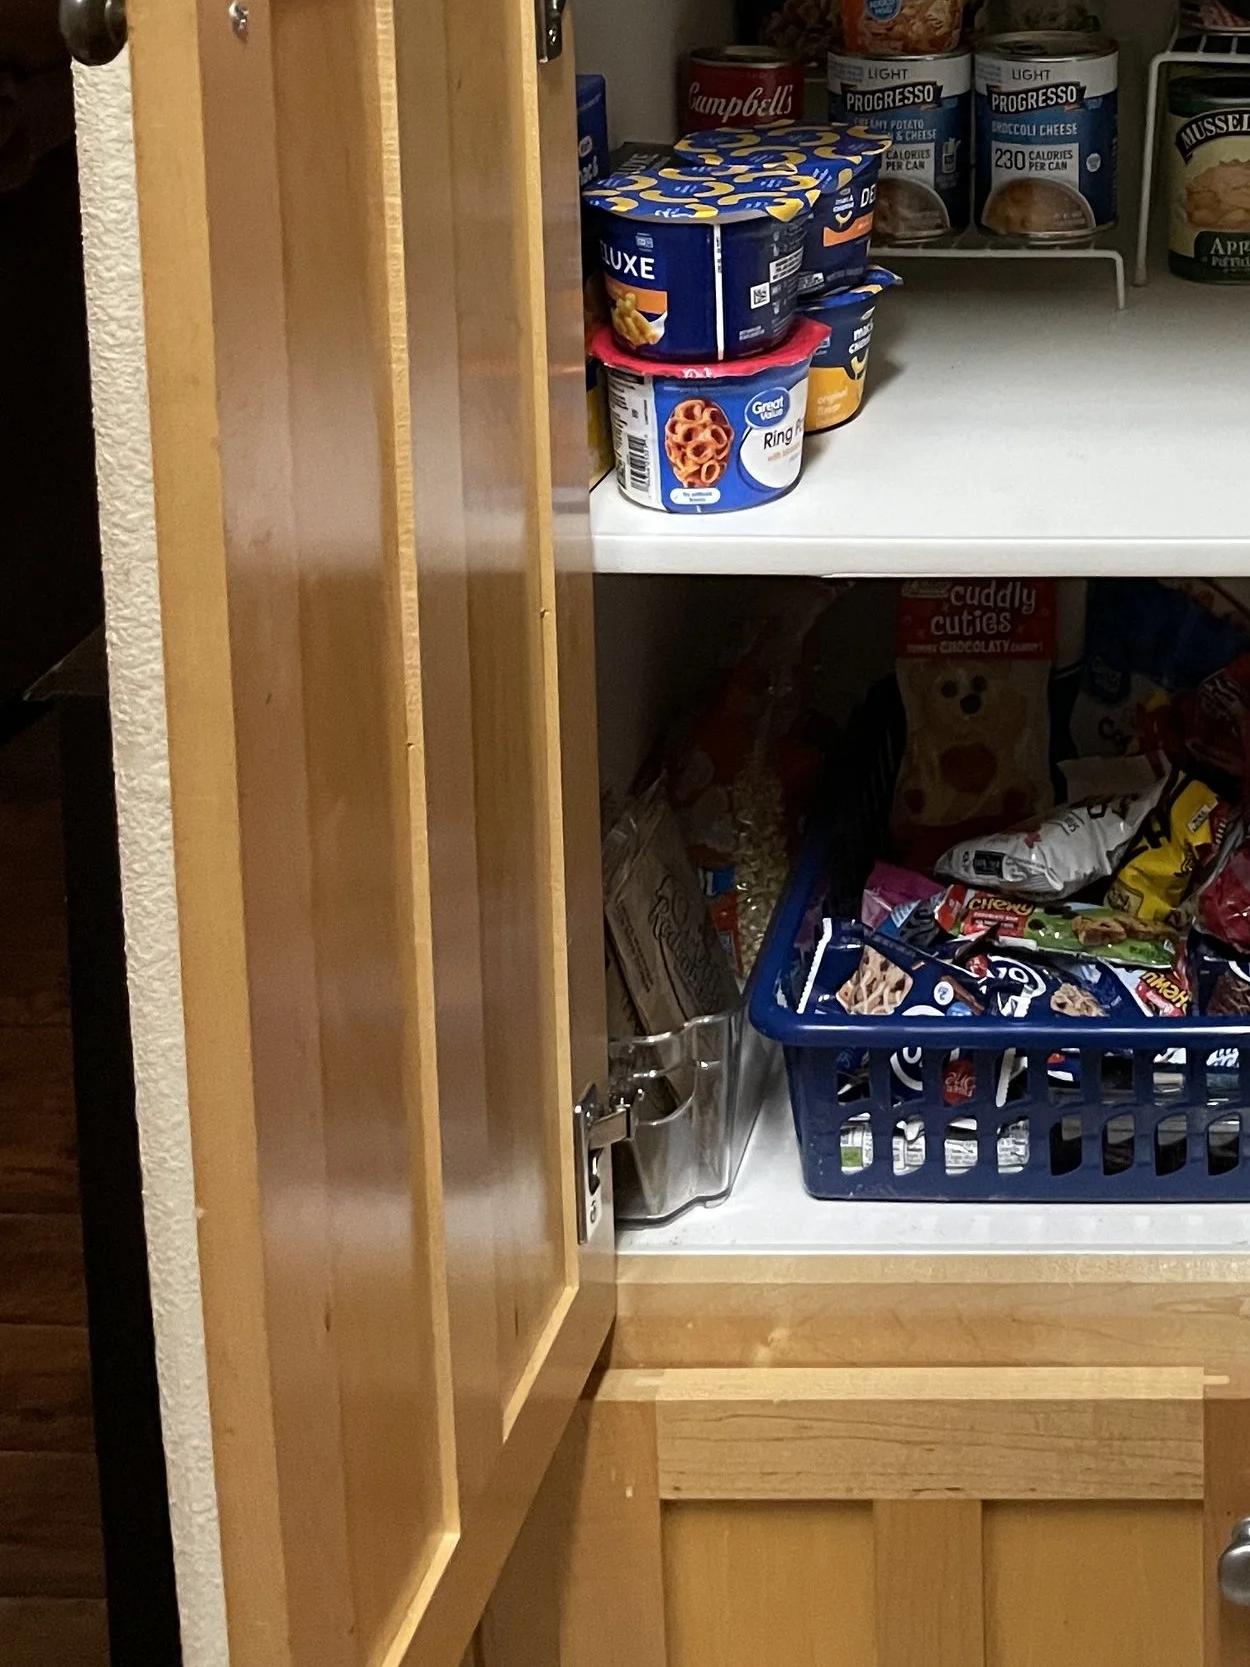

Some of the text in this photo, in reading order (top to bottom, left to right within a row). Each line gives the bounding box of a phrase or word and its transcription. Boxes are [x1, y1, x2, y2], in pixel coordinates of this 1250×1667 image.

[868, 68, 908, 80] LIGHT
[1012, 69, 1051, 81] LIGHT
[688, 83, 793, 124] Campbell's
[847, 85, 934, 112] PROGRESSO
[991, 85, 1077, 113] PROGRESSO
[890, 119, 924, 130] POTATO
[991, 120, 1078, 136] BROCCOLI CHEESE
[896, 129, 937, 141] & CHEESE
[886, 149, 931, 160] CALORIES
[995, 148, 1073, 170] 230 CALORIES
[886, 160, 925, 171] PER CAN
[1028, 161, 1067, 171] PER CAN
[752, 395, 784, 415] Great
[760, 407, 783, 421] Value
[763, 427, 793, 449] Ring
[951, 579, 1036, 615] cuddly
[930, 610, 1012, 636] cuties
[939, 640, 1010, 654] CHOCOLATY
